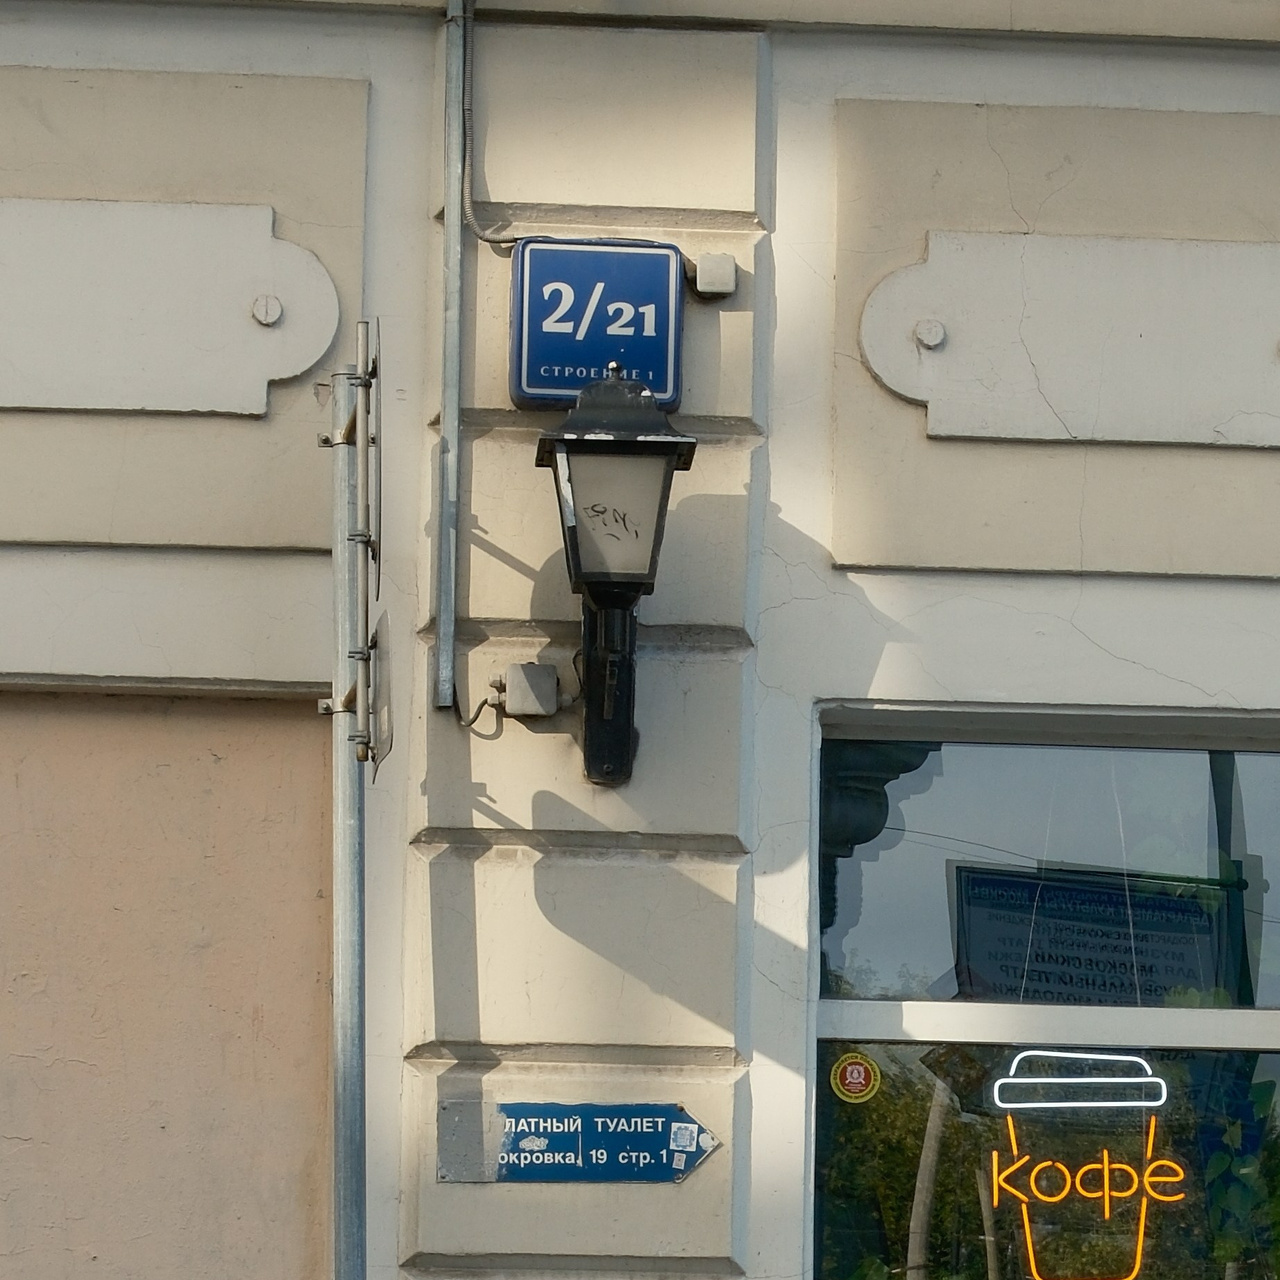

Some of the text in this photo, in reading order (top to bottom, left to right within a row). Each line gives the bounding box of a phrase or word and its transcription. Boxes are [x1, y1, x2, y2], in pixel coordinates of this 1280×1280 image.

[541, 281, 657, 341] 2/21
[540, 365, 654, 380] СТРОЕНИЕ 1
[594, 1117, 666, 1133] ТУАЛЕТ
[588, 1149, 608, 1165] 19
[617, 1150, 655, 1169] стр.
[660, 1149, 668, 1165] 1
